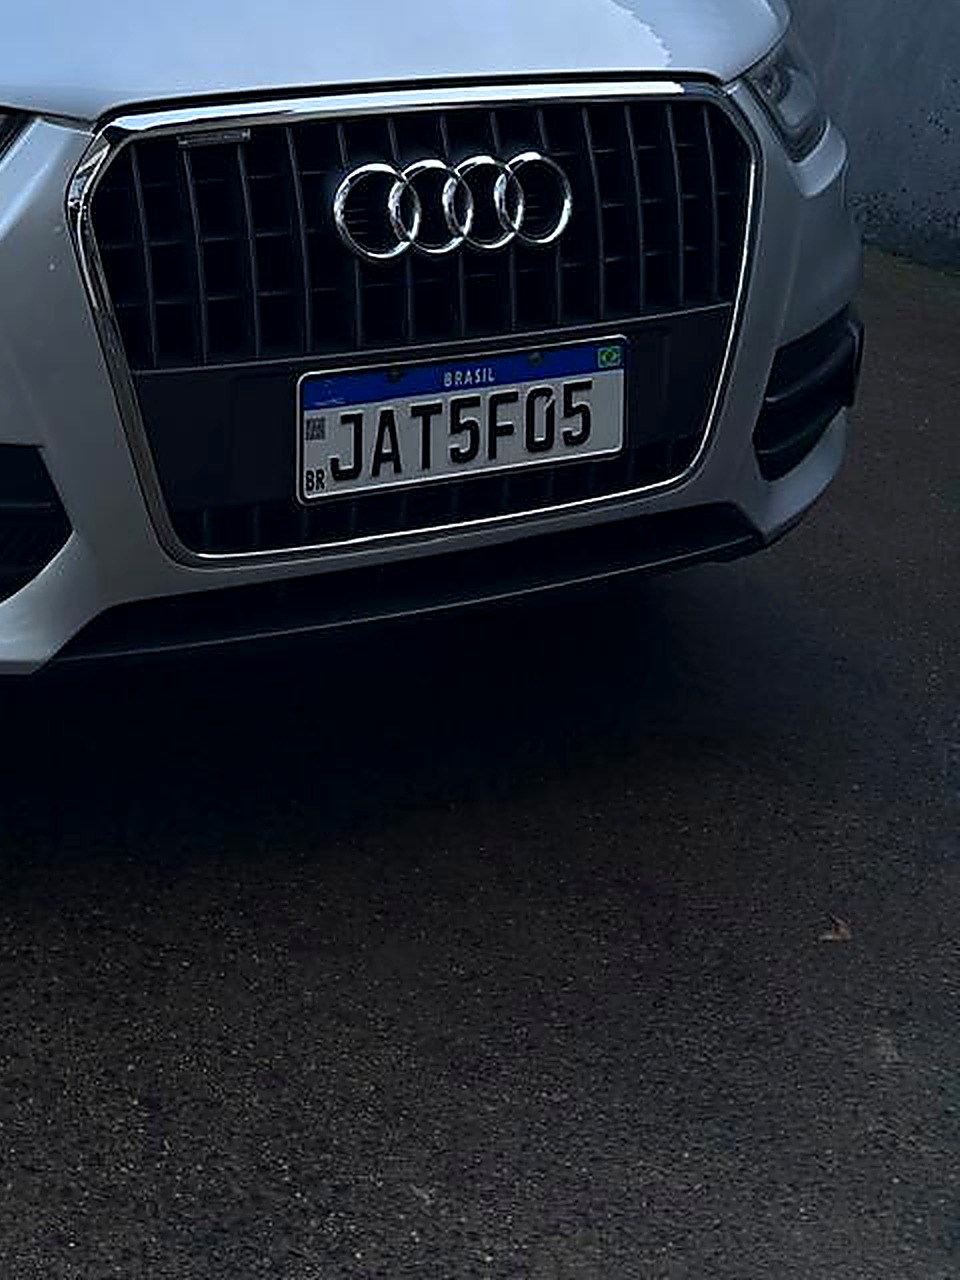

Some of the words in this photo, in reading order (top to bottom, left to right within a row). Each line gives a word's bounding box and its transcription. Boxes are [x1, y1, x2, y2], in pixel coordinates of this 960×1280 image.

[443, 367, 496, 388] BRASIL
[330, 378, 593, 482] JAT5F05
[305, 467, 326, 491] BR
